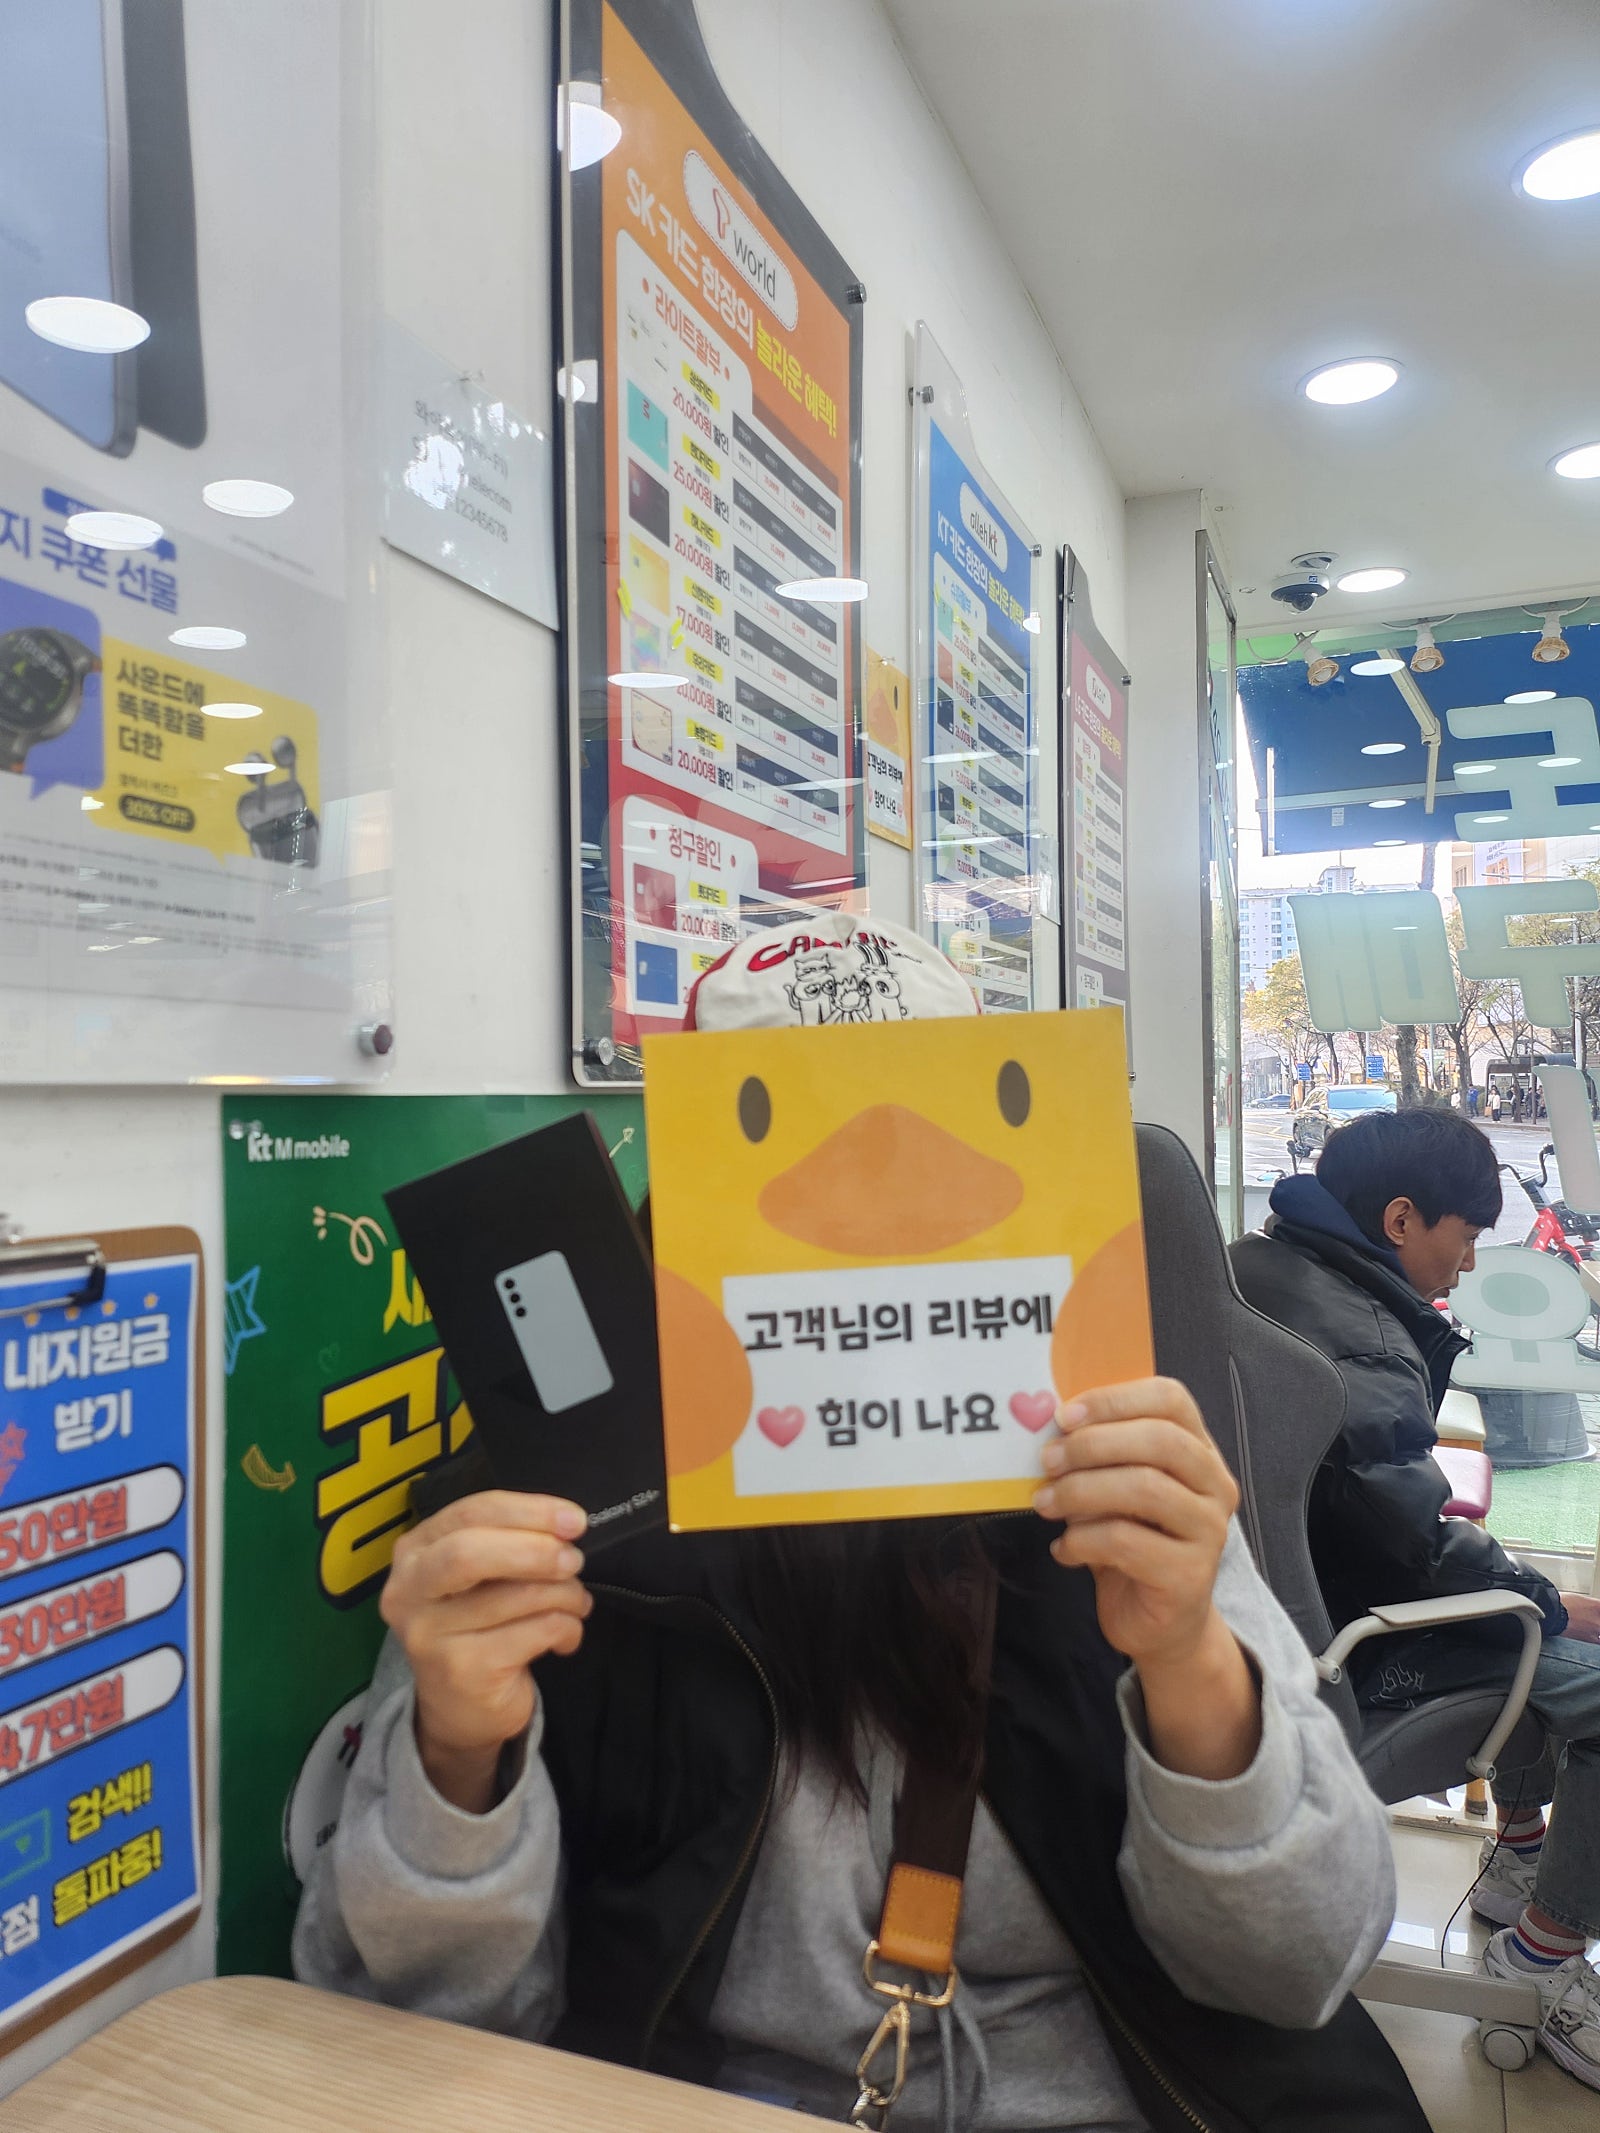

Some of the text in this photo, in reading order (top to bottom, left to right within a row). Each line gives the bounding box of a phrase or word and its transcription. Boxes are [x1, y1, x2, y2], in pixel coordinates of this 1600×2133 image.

[733, 230, 776, 301] world
[627, 167, 838, 440] SK 카드 한정의 놀라운 혜택!
[654, 283, 721, 377] 라이트할부
[672, 386, 730, 456] 20,000원 할인
[673, 460, 730, 524] 25,000원 할인
[674, 533, 731, 591] 20,000원 할인
[937, 510, 949, 546] KT
[949, 525, 966, 568] 카드
[966, 545, 988, 595] 한정의
[970, 511, 998, 557] olleh kt
[116, 556, 178, 616] 선물
[714, 629, 731, 657] 할인
[117, 658, 205, 709] 사운드에
[716, 698, 733, 724] 할인
[119, 725, 164, 762] 더한
[677, 745, 734, 791] 20,000원 할인
[874, 789, 897, 815] 힘이 나요
[668, 824, 721, 871] 청구할인
[247, 1132, 350, 1162] kt M mobile
[745, 1295, 1054, 1352] 고객님의 리뷰에
[54, 1389, 132, 1452] 받기
[817, 1392, 1000, 1447] 힘이 나요
[587, 1499, 633, 1529] Galaxy
[67, 1760, 153, 1844] 검색!!
[53, 1826, 163, 1928] 돌파중!
